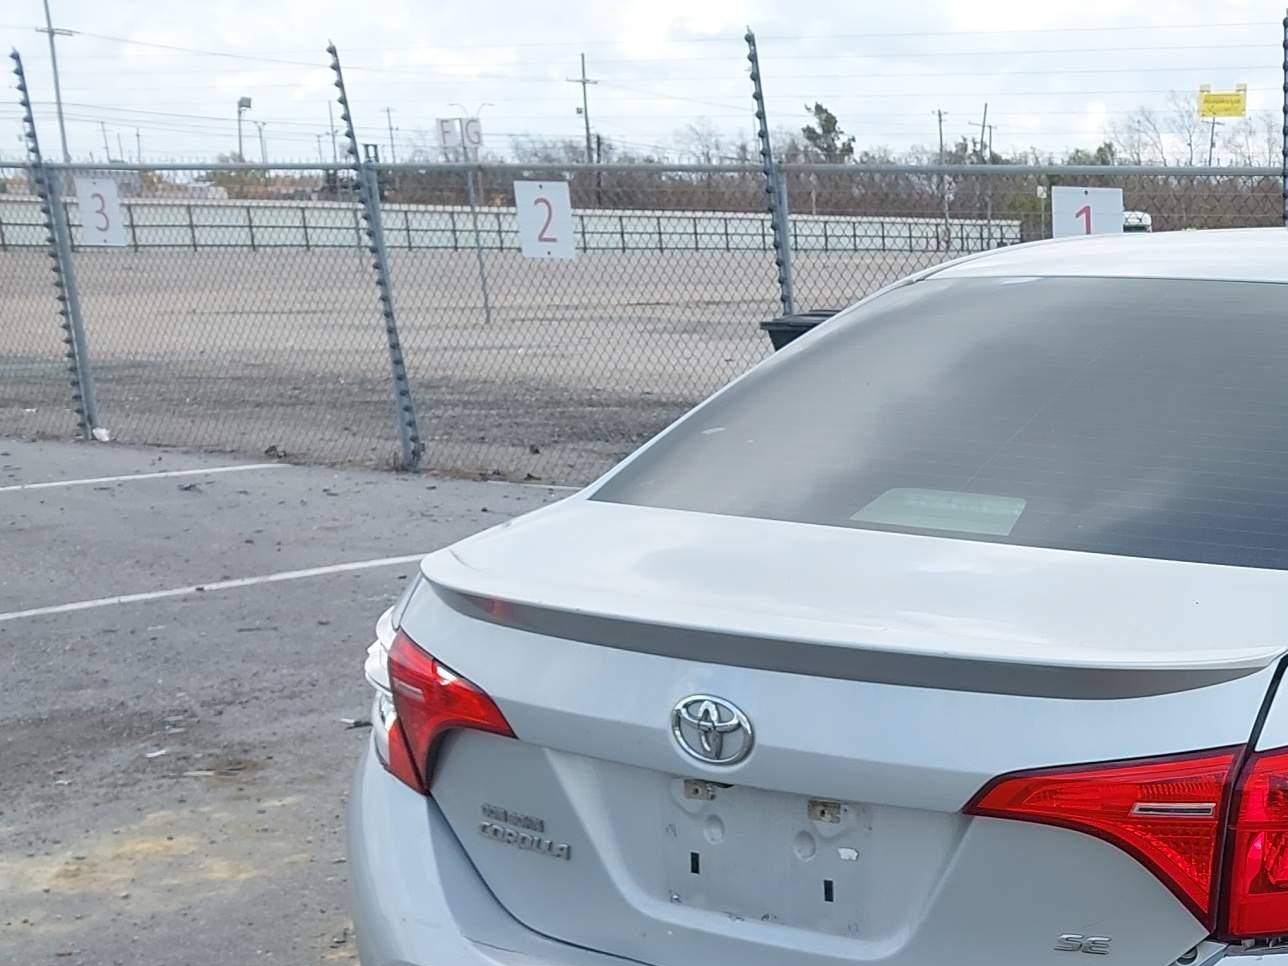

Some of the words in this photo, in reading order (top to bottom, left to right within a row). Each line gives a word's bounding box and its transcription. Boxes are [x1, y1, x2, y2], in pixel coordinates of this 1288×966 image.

[465, 119, 481, 145] G
[91, 192, 110, 231] 3
[534, 197, 557, 242] 2
[1075, 205, 1092, 235] 1
[480, 821, 572, 861] COROLLA
[1055, 932, 1112, 955] SE
